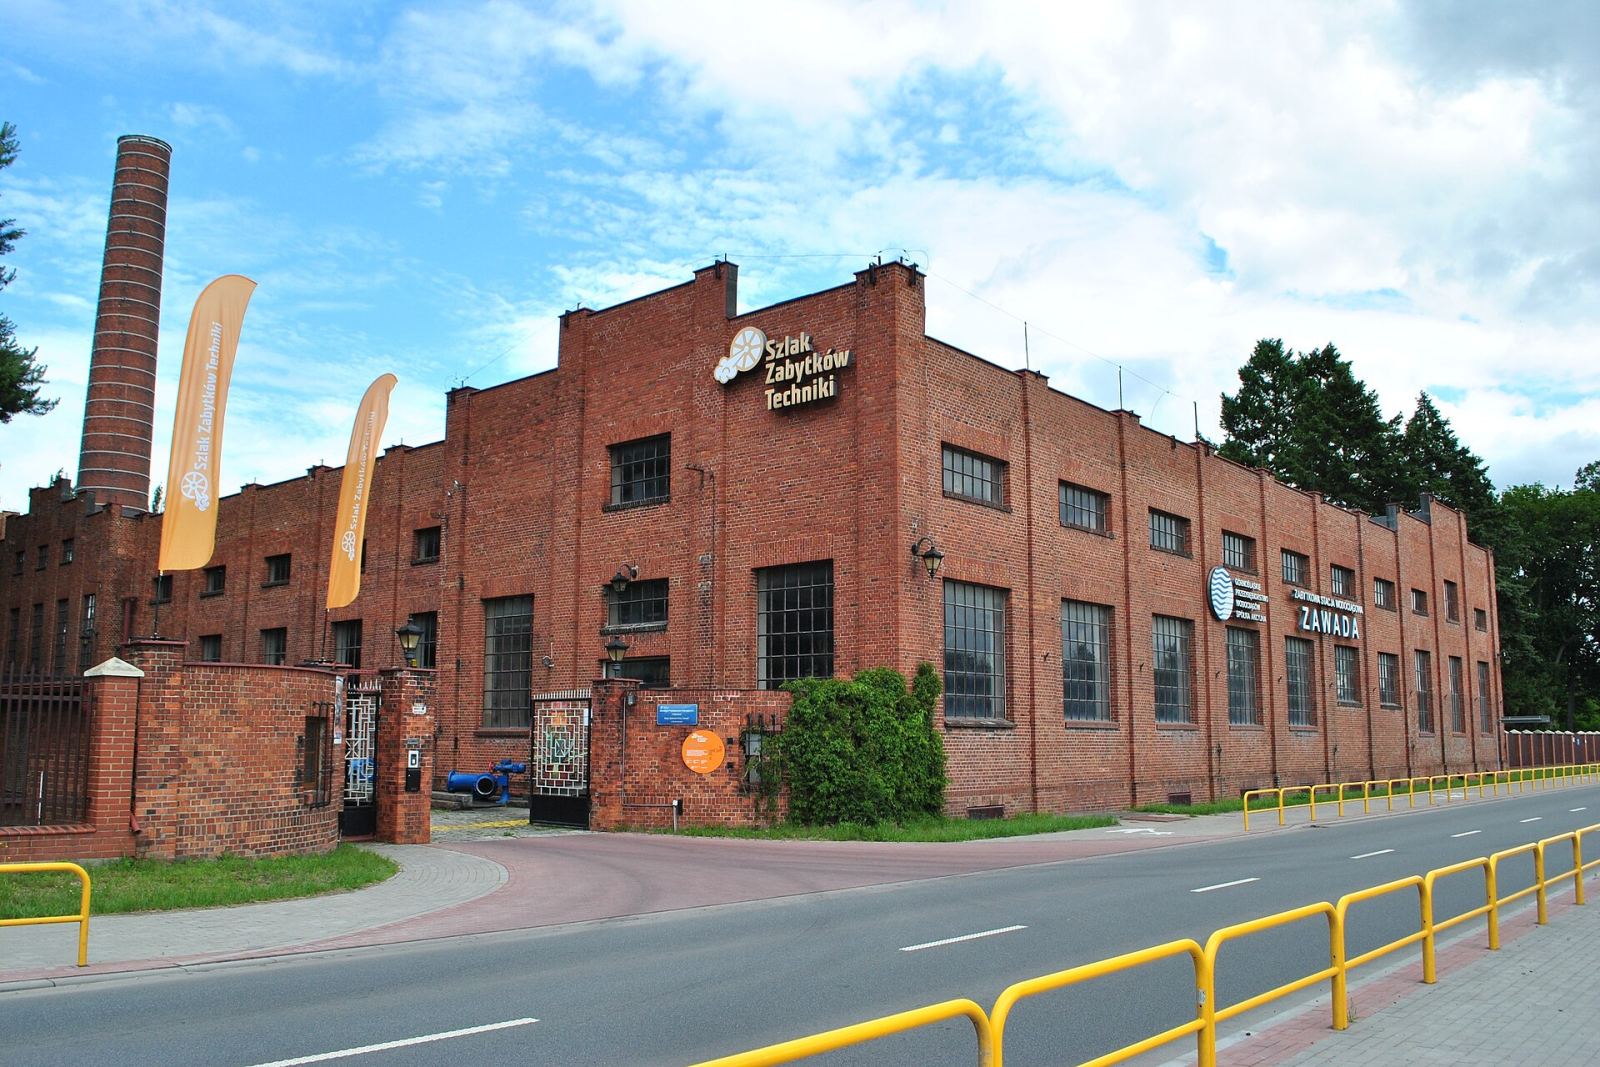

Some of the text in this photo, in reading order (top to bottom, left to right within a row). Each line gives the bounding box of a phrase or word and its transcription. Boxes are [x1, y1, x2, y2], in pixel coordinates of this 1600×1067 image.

[765, 331, 812, 361] Szlak
[765, 348, 850, 385] Zabytków
[193, 321, 223, 471] Szlak Zabytków Techniki
[764, 375, 834, 410] Techniki
[1301, 605, 1360, 640] ZAWADA
